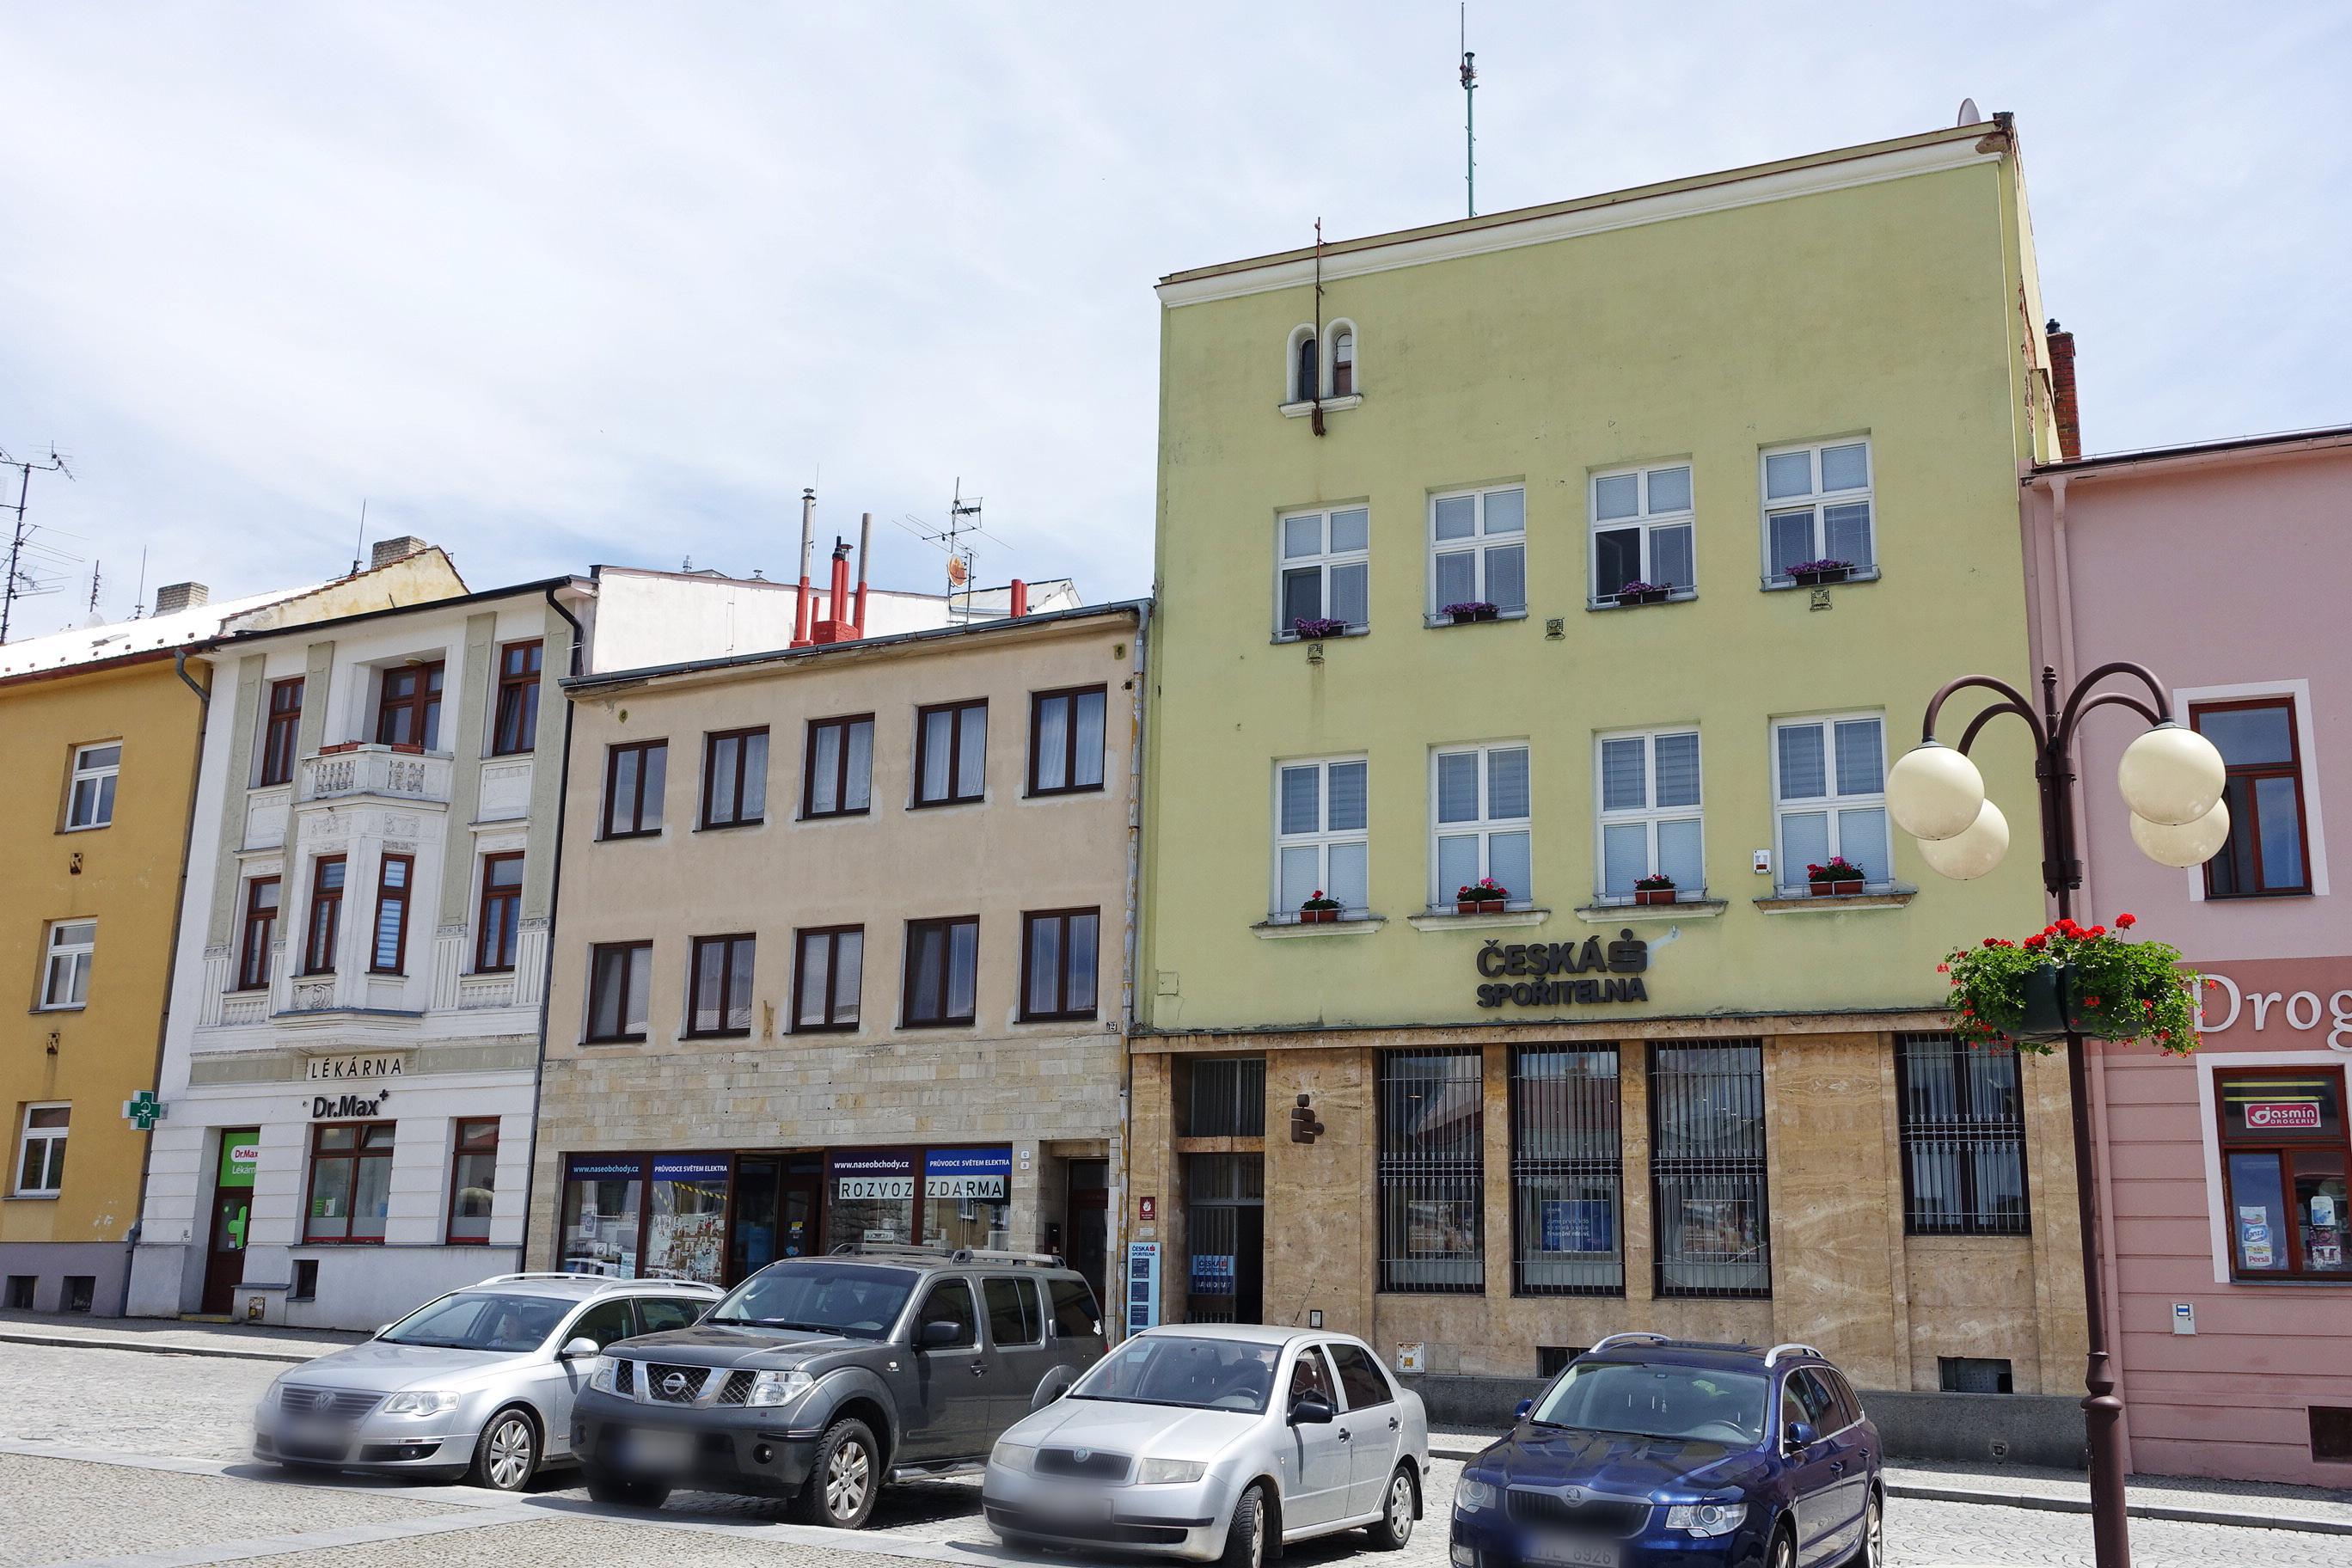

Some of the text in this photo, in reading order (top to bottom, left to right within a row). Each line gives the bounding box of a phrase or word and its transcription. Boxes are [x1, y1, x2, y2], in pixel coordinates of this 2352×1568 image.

[1477, 935, 1607, 978] ČESKÁ
[1477, 977, 1648, 1008] SPOŘITELNA
[2186, 973, 2352, 1052] Drog
[311, 1056, 402, 1079] LÉKÁRNA
[235, 1149, 259, 1159] Dr.Max
[573, 1165, 639, 1173] www.naseobchody.cz
[834, 1160, 909, 1169] www.naseobchody.cz
[842, 1182, 913, 1197] ROZVOZ
[927, 1181, 1002, 1197] ZDARMA
